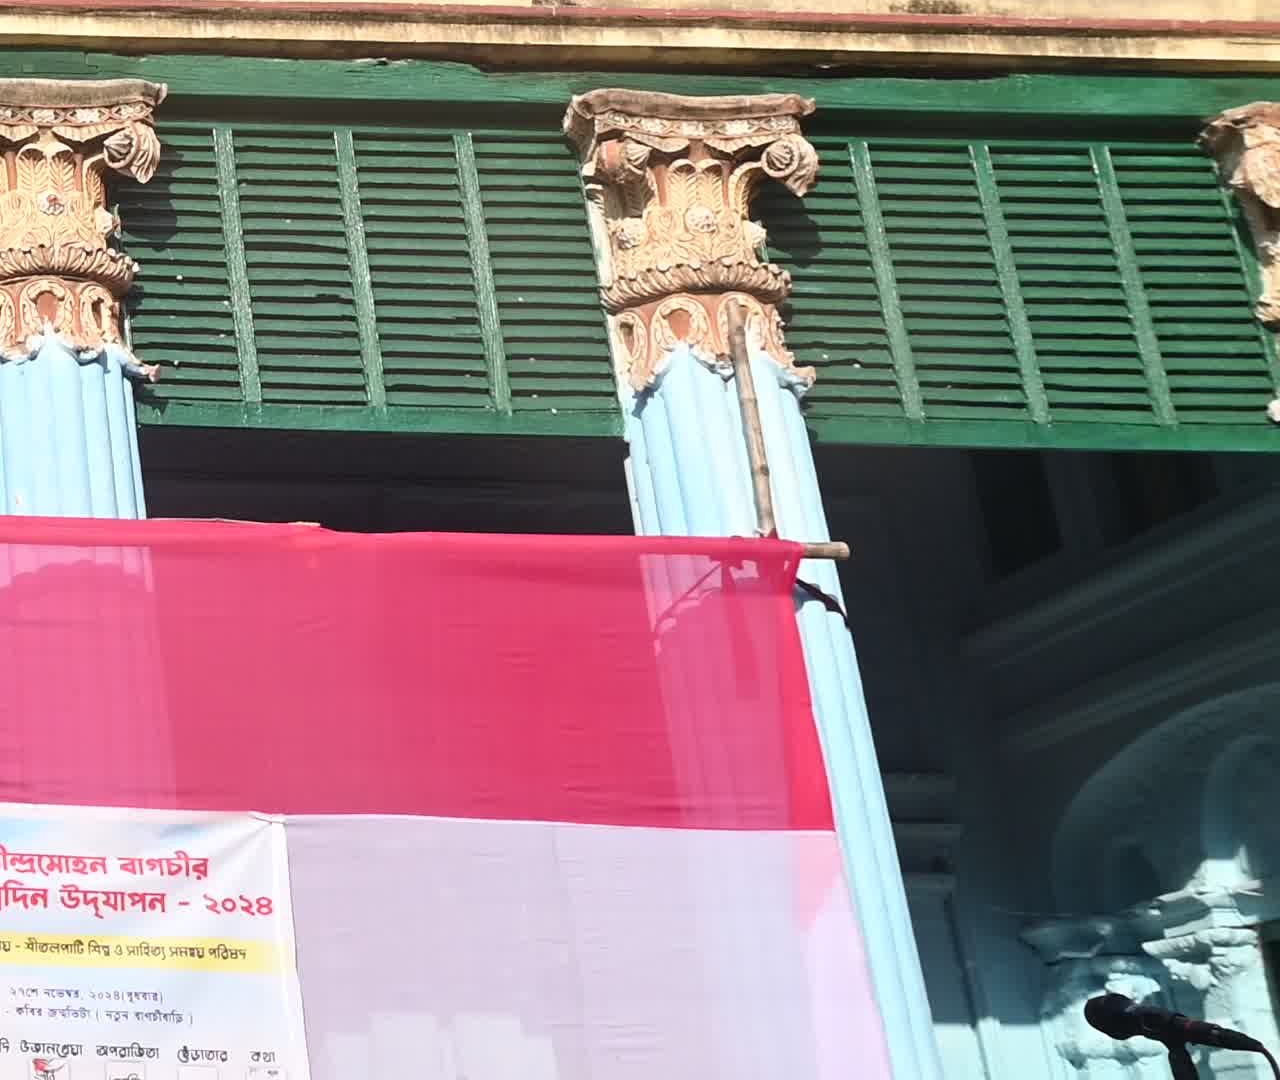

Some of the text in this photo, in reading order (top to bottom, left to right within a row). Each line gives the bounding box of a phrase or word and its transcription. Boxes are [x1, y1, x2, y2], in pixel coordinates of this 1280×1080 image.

[117, 850, 209, 880] বাগচীর
[203, 893, 273, 916] ২০২৪
[114, 944, 123, 956] ও
[96, 1042, 160, 1060] অপরাজিতা
